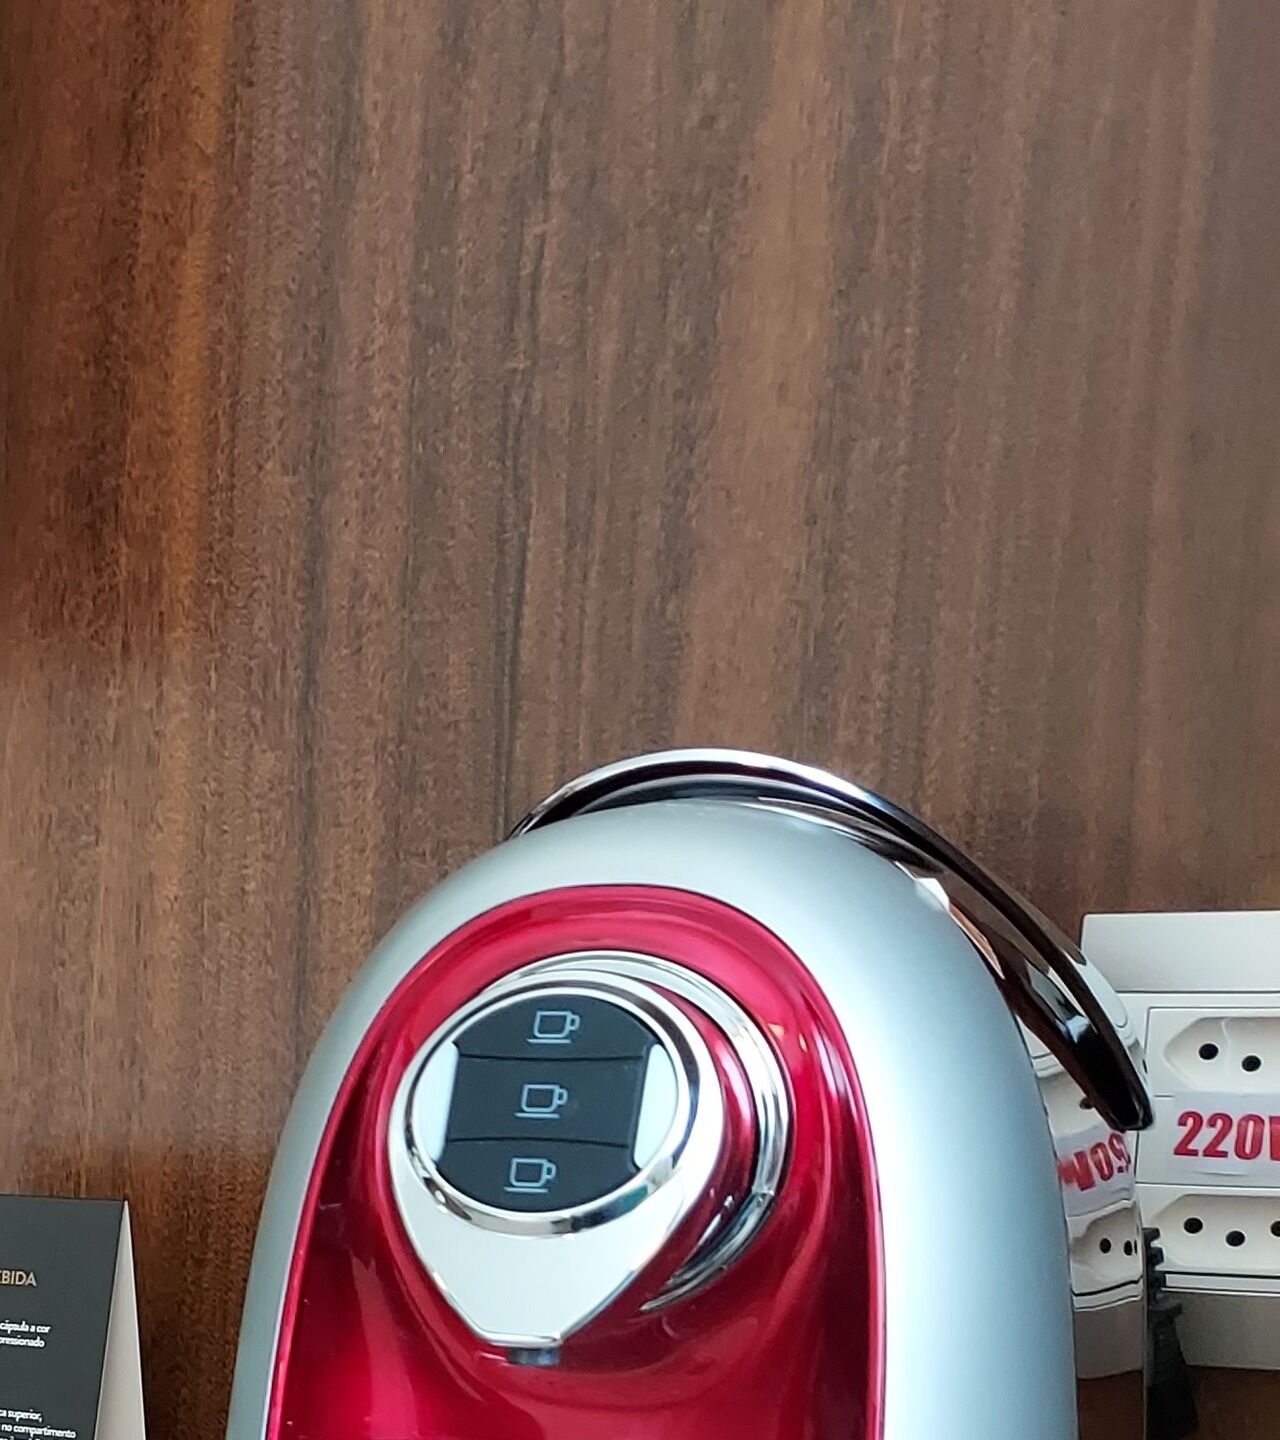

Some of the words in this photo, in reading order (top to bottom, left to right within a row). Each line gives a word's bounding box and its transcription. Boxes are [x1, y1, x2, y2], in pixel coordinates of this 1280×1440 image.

[0, 1319, 30, 1334] cápsula
[36, 1325, 51, 1333] cor
[2, 1423, 13, 1432] no
[13, 1426, 77, 1439] compartimento
